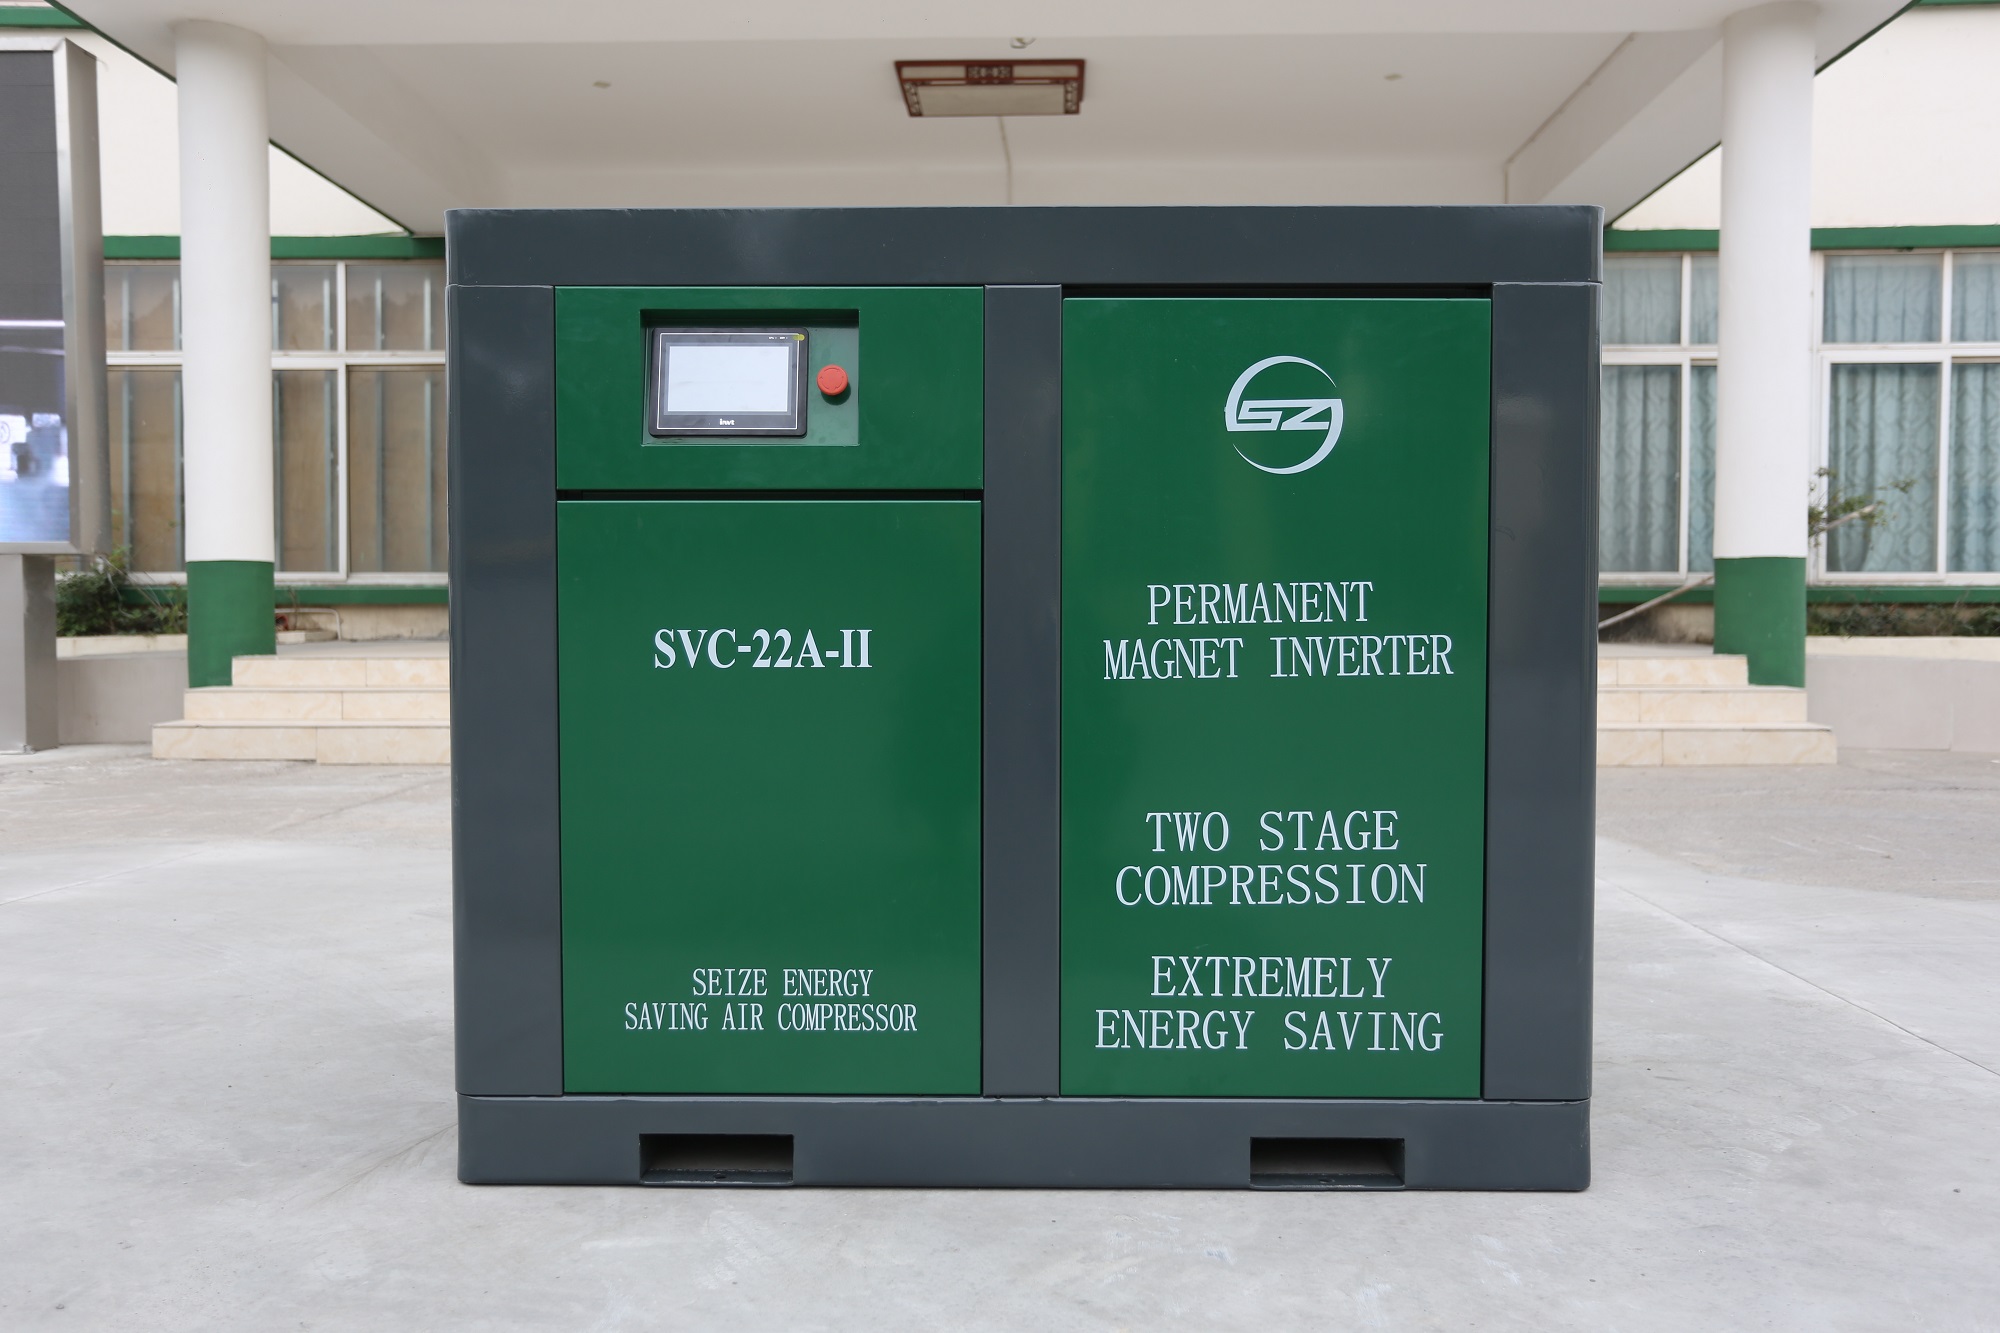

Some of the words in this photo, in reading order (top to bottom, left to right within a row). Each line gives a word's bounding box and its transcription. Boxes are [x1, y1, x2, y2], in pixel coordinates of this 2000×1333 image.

[1147, 582, 1373, 625] PERMANENT
[654, 628, 873, 669] SVC-22A-II
[1103, 637, 1243, 680] MAGNET
[1270, 635, 1454, 678] INVERTER
[1145, 811, 1229, 852] TWO
[1259, 810, 1399, 851] STAGE
[1115, 863, 1427, 906] COMPRESSION
[692, 968, 768, 996] SEIZE
[783, 968, 873, 997] ENERGY
[1151, 956, 1392, 998] EXTREMELY
[625, 1002, 708, 1030] SAVING
[722, 1002, 764, 1030] AIR
[777, 1003, 918, 1032] COMPRESSOR
[1095, 1009, 1255, 1050] ENERGY
[1283, 1010, 1443, 1051] SAVING
